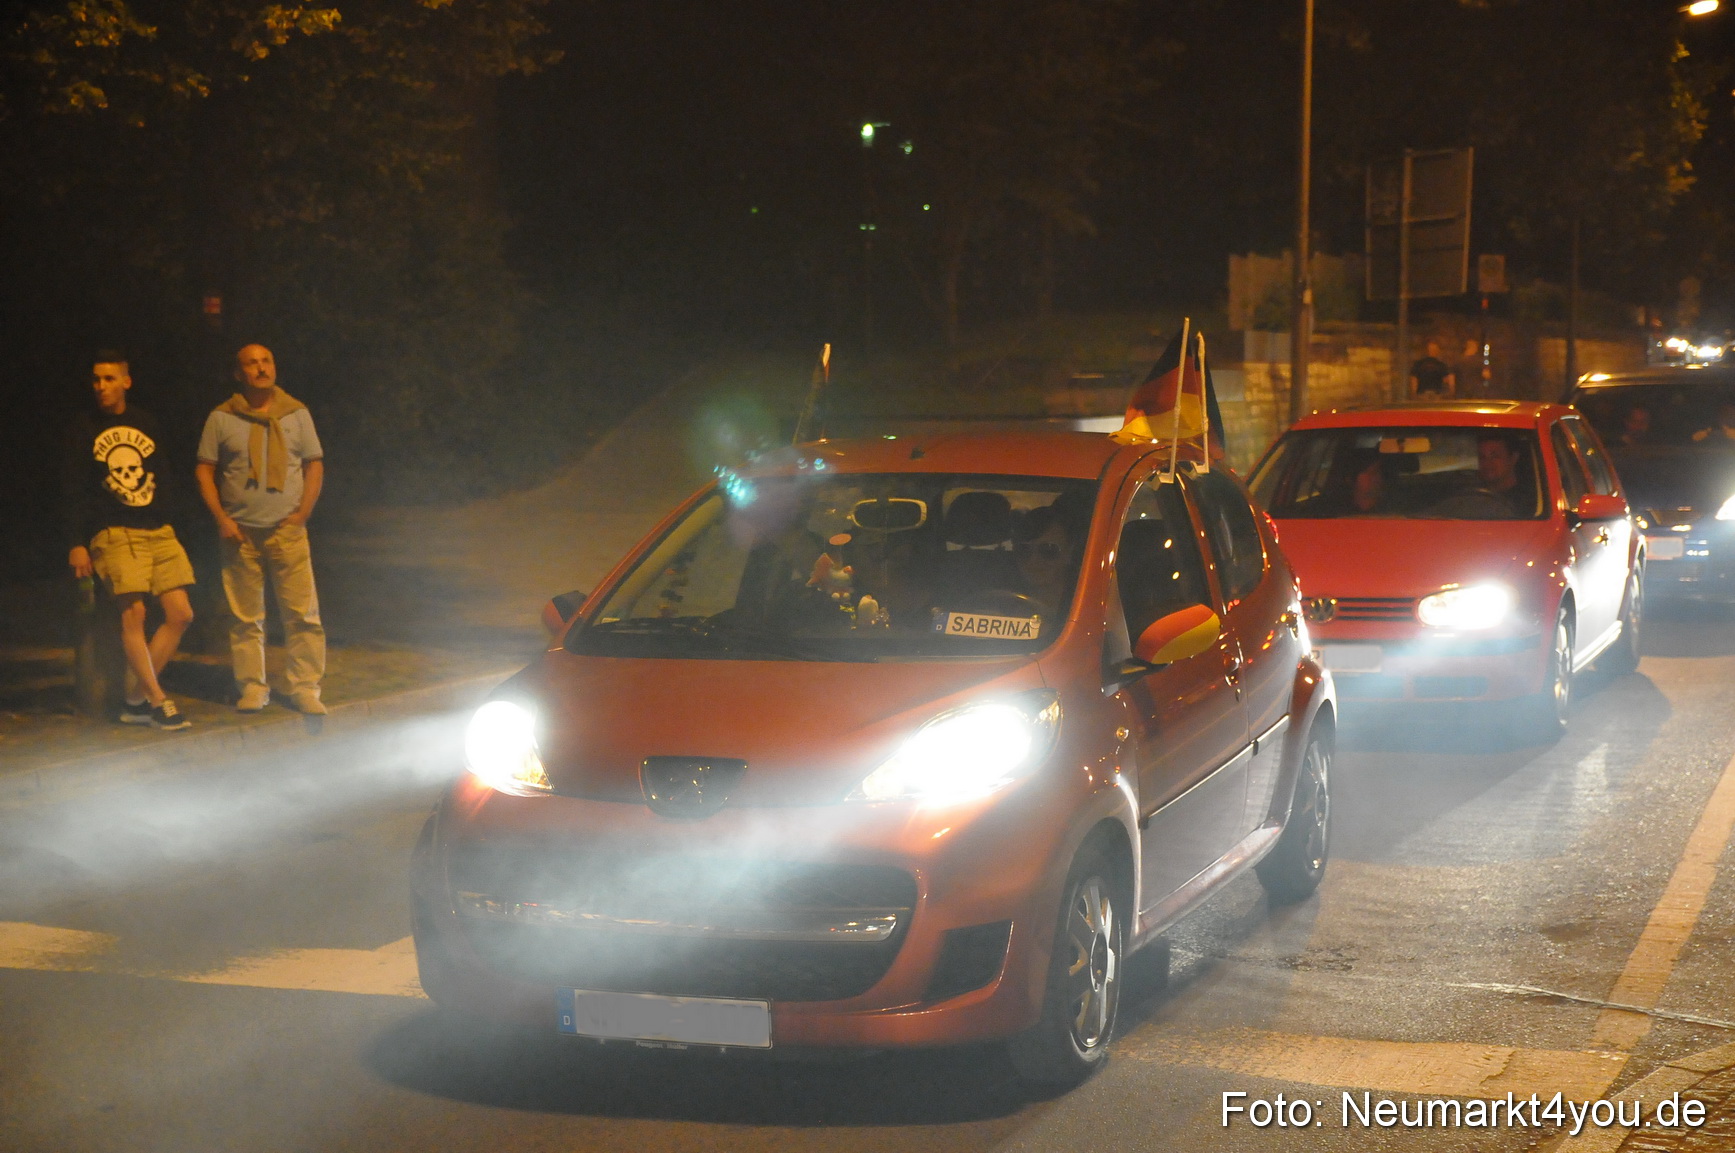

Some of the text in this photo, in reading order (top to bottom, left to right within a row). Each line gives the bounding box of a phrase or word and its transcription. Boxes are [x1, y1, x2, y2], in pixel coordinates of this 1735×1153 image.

[95, 431, 154, 458] THUG LIFE
[951, 616, 1032, 638] SABRINA
[563, 1015, 571, 1026] D
